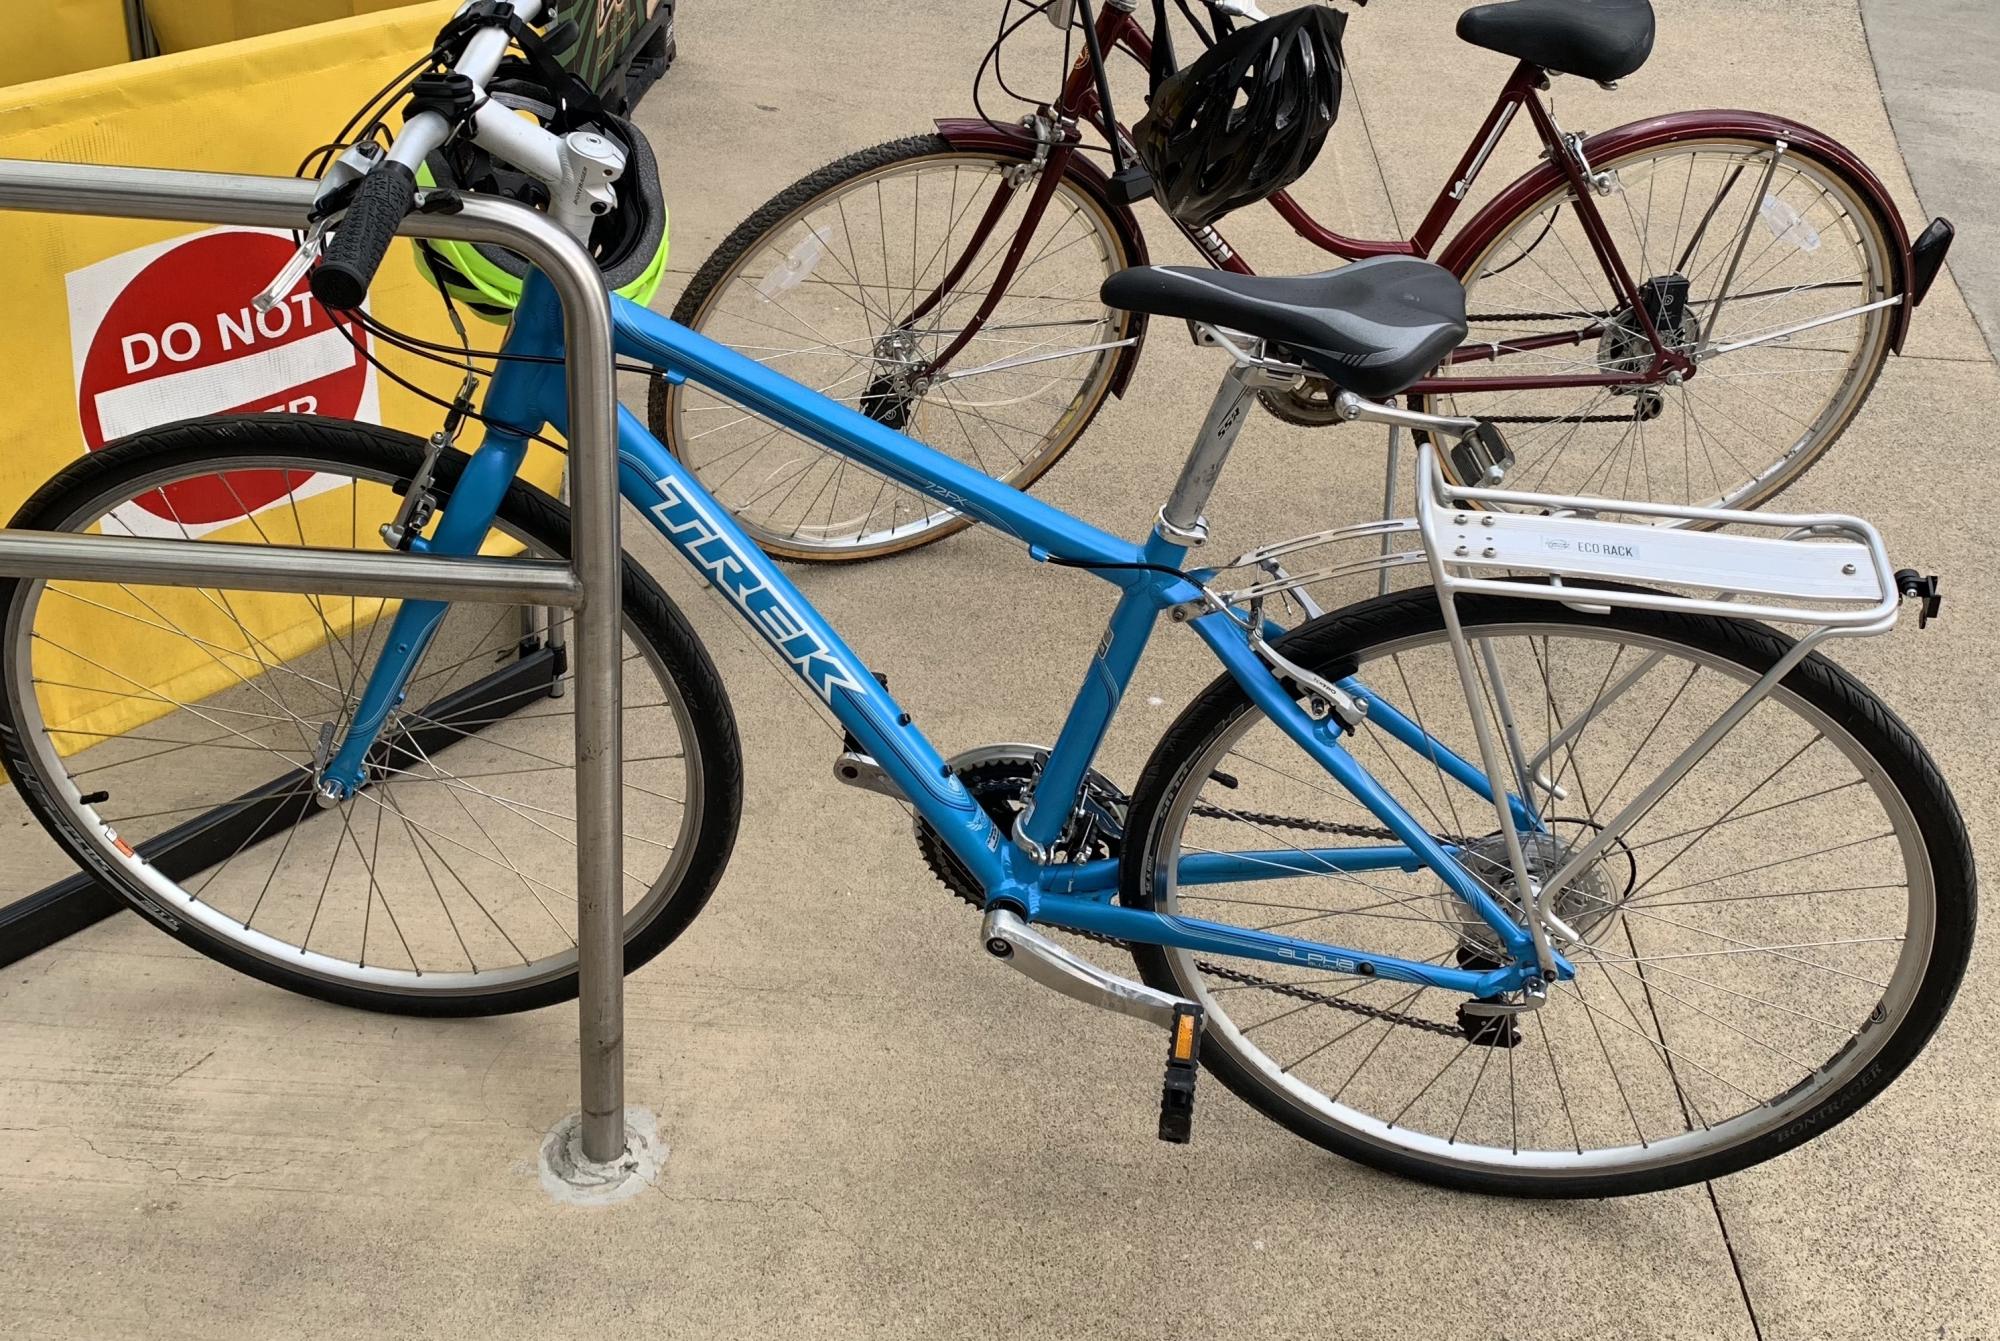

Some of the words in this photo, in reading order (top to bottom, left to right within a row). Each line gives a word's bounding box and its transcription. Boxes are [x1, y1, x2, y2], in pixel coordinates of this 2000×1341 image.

[121, 321, 202, 374] DO
[216, 290, 315, 351] NOT
[650, 474, 868, 706] TREK
[1577, 541, 1600, 554] ECO
[1603, 544, 1633, 557] RACK
[1776, 1062, 1885, 1143] BONTRAGER
